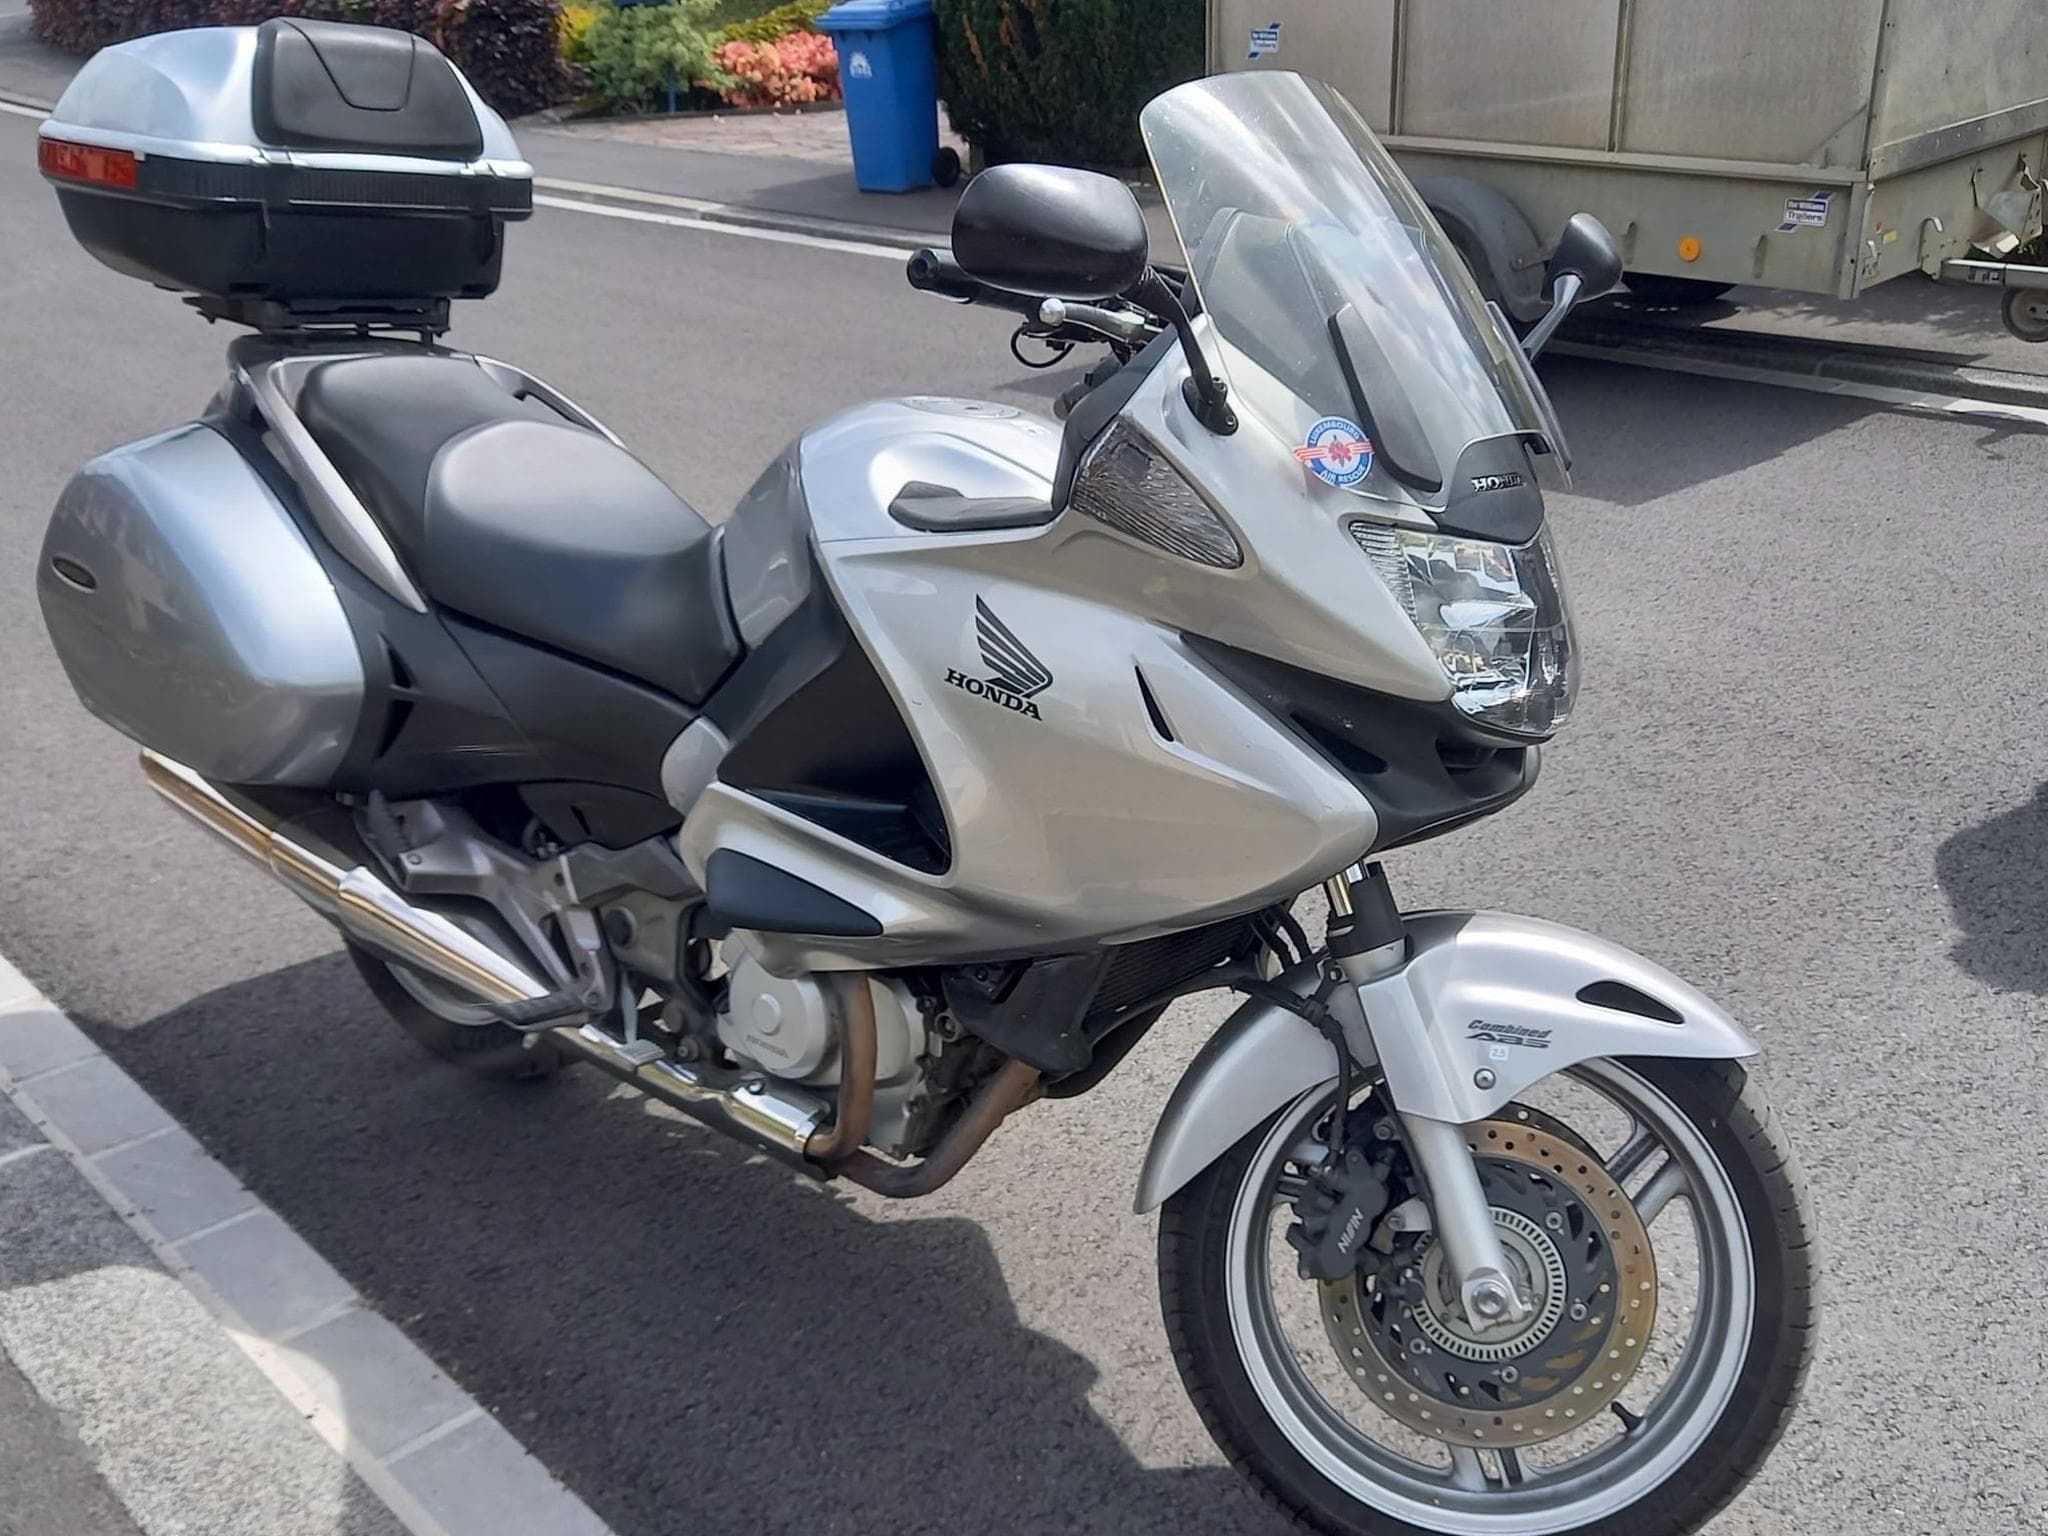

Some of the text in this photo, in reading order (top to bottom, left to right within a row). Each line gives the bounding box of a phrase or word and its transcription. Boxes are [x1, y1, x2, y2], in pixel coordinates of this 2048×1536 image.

[943, 667, 1042, 721] HONDA
[1467, 1019, 1552, 1039] Combined
[1463, 1032, 1551, 1049] ABS
